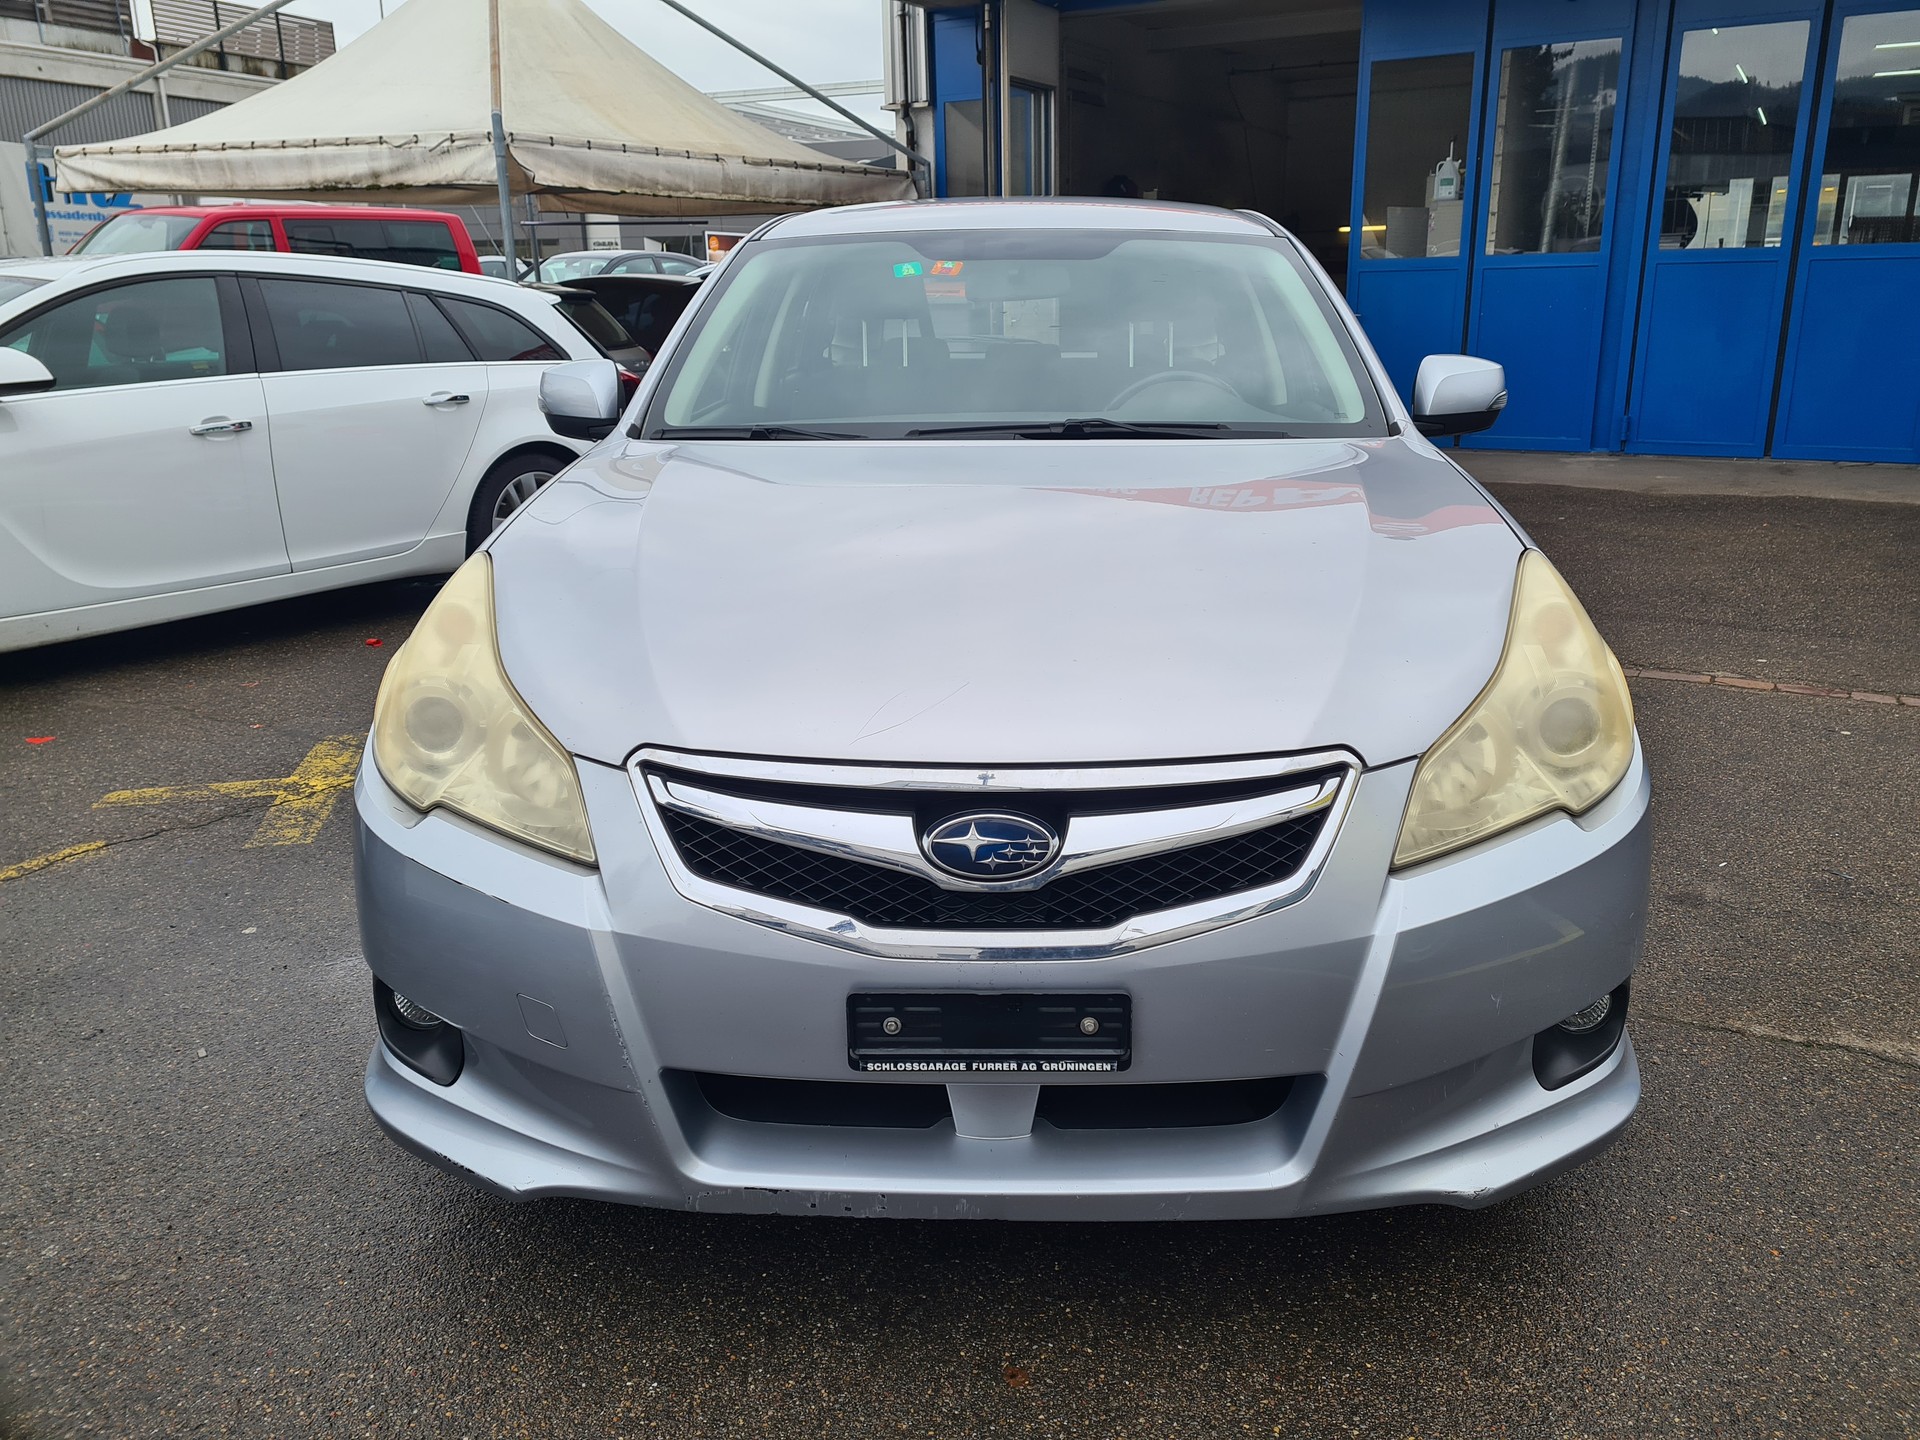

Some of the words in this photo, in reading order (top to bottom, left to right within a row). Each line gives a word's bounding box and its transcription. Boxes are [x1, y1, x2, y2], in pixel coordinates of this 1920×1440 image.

[866, 1062, 967, 1072] SCHLOSSGARAGE
[972, 1062, 1018, 1072] FURRER
[1020, 1062, 1037, 1072] AG
[1041, 1060, 1111, 1072] GRÜNINGEN
